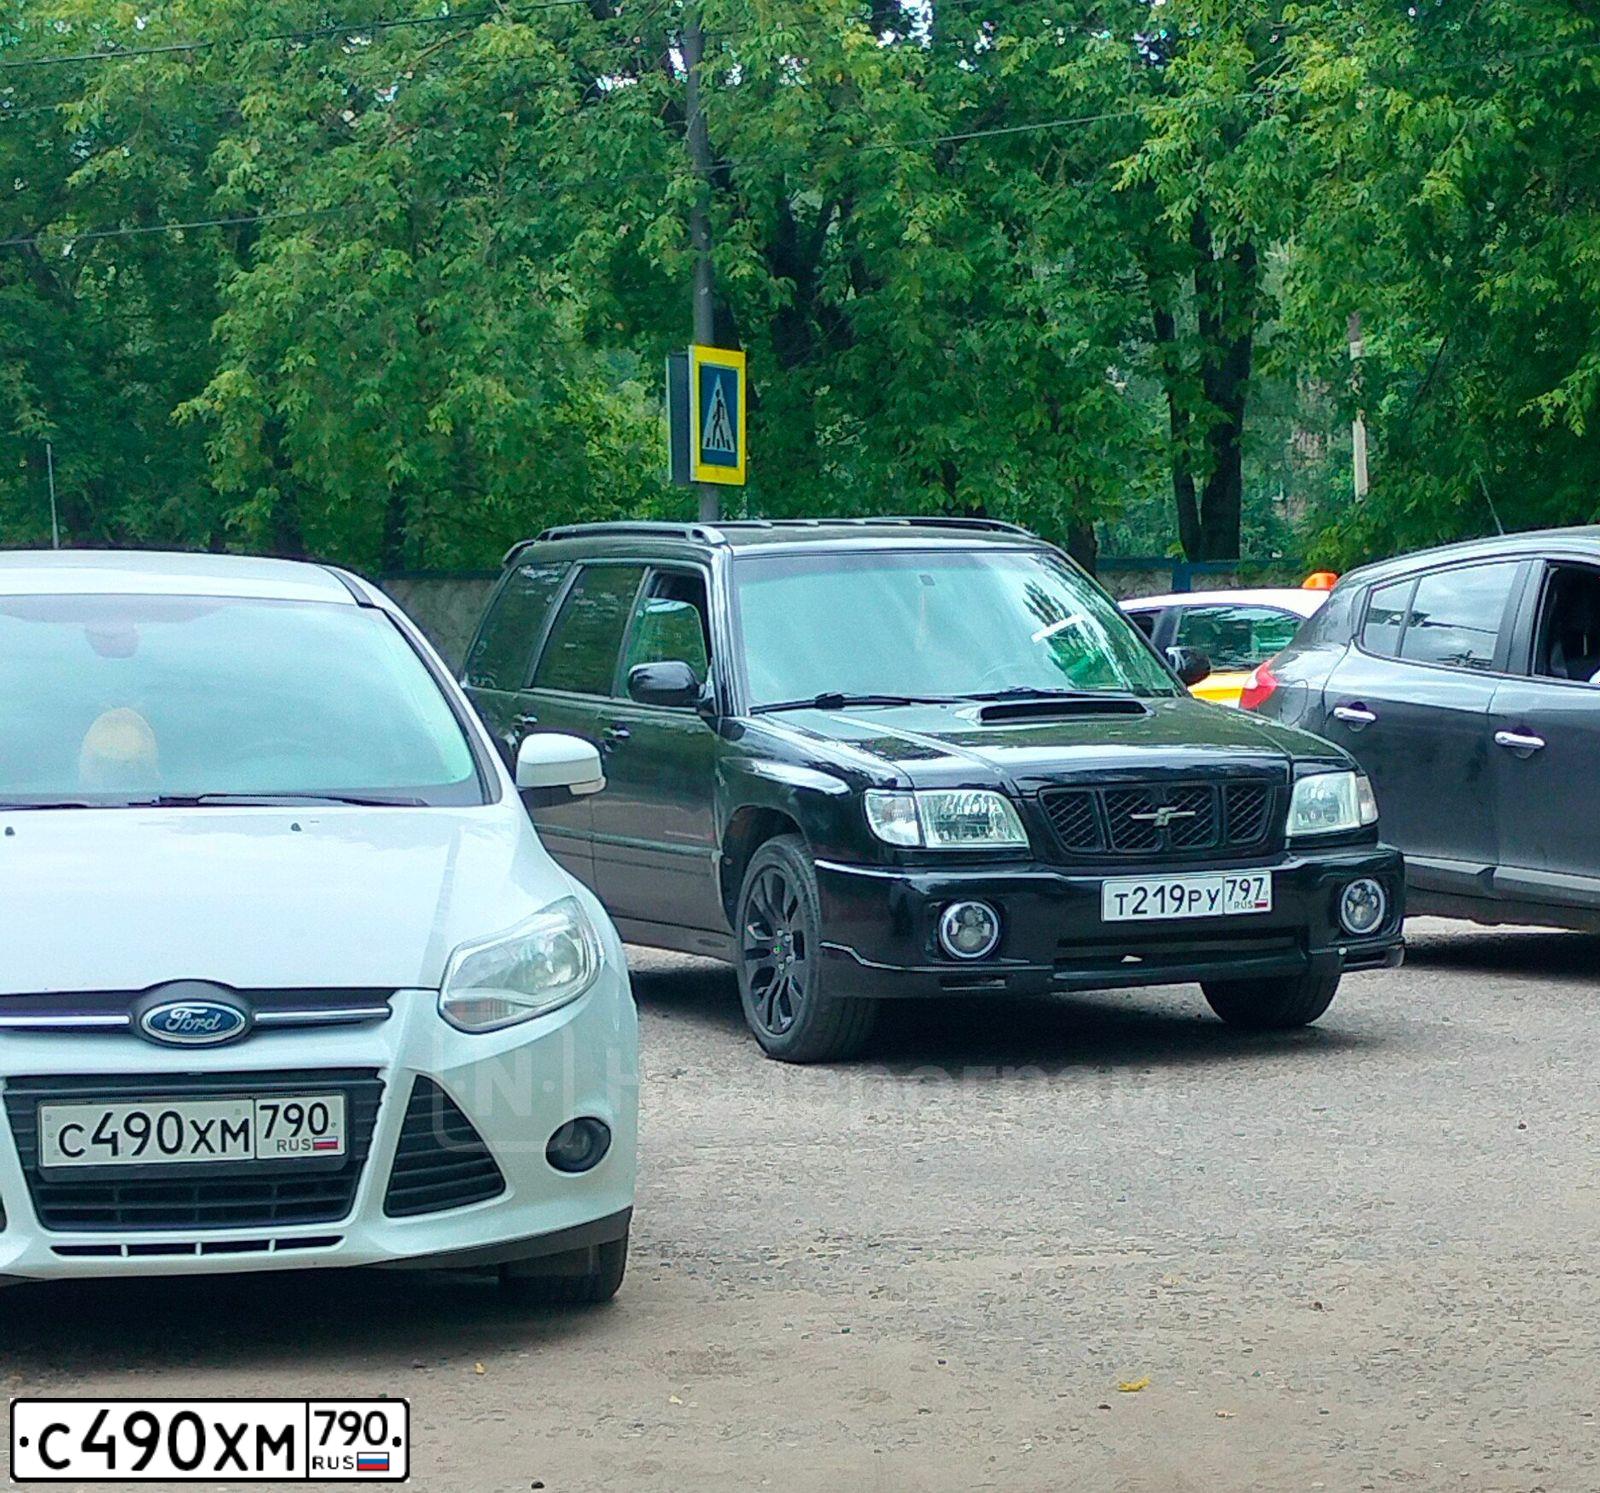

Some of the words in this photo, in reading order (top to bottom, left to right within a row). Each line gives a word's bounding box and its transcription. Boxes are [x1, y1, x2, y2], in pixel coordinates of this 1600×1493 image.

[1114, 884, 1220, 916] Т219РУ
[1225, 877, 1265, 902] 797
[1233, 901, 1254, 910] RUS
[165, 1007, 221, 1031] Ford
[259, 1102, 329, 1139] 790
[58, 1111, 250, 1158] С490ХМ
[276, 1138, 311, 1152] RUS
